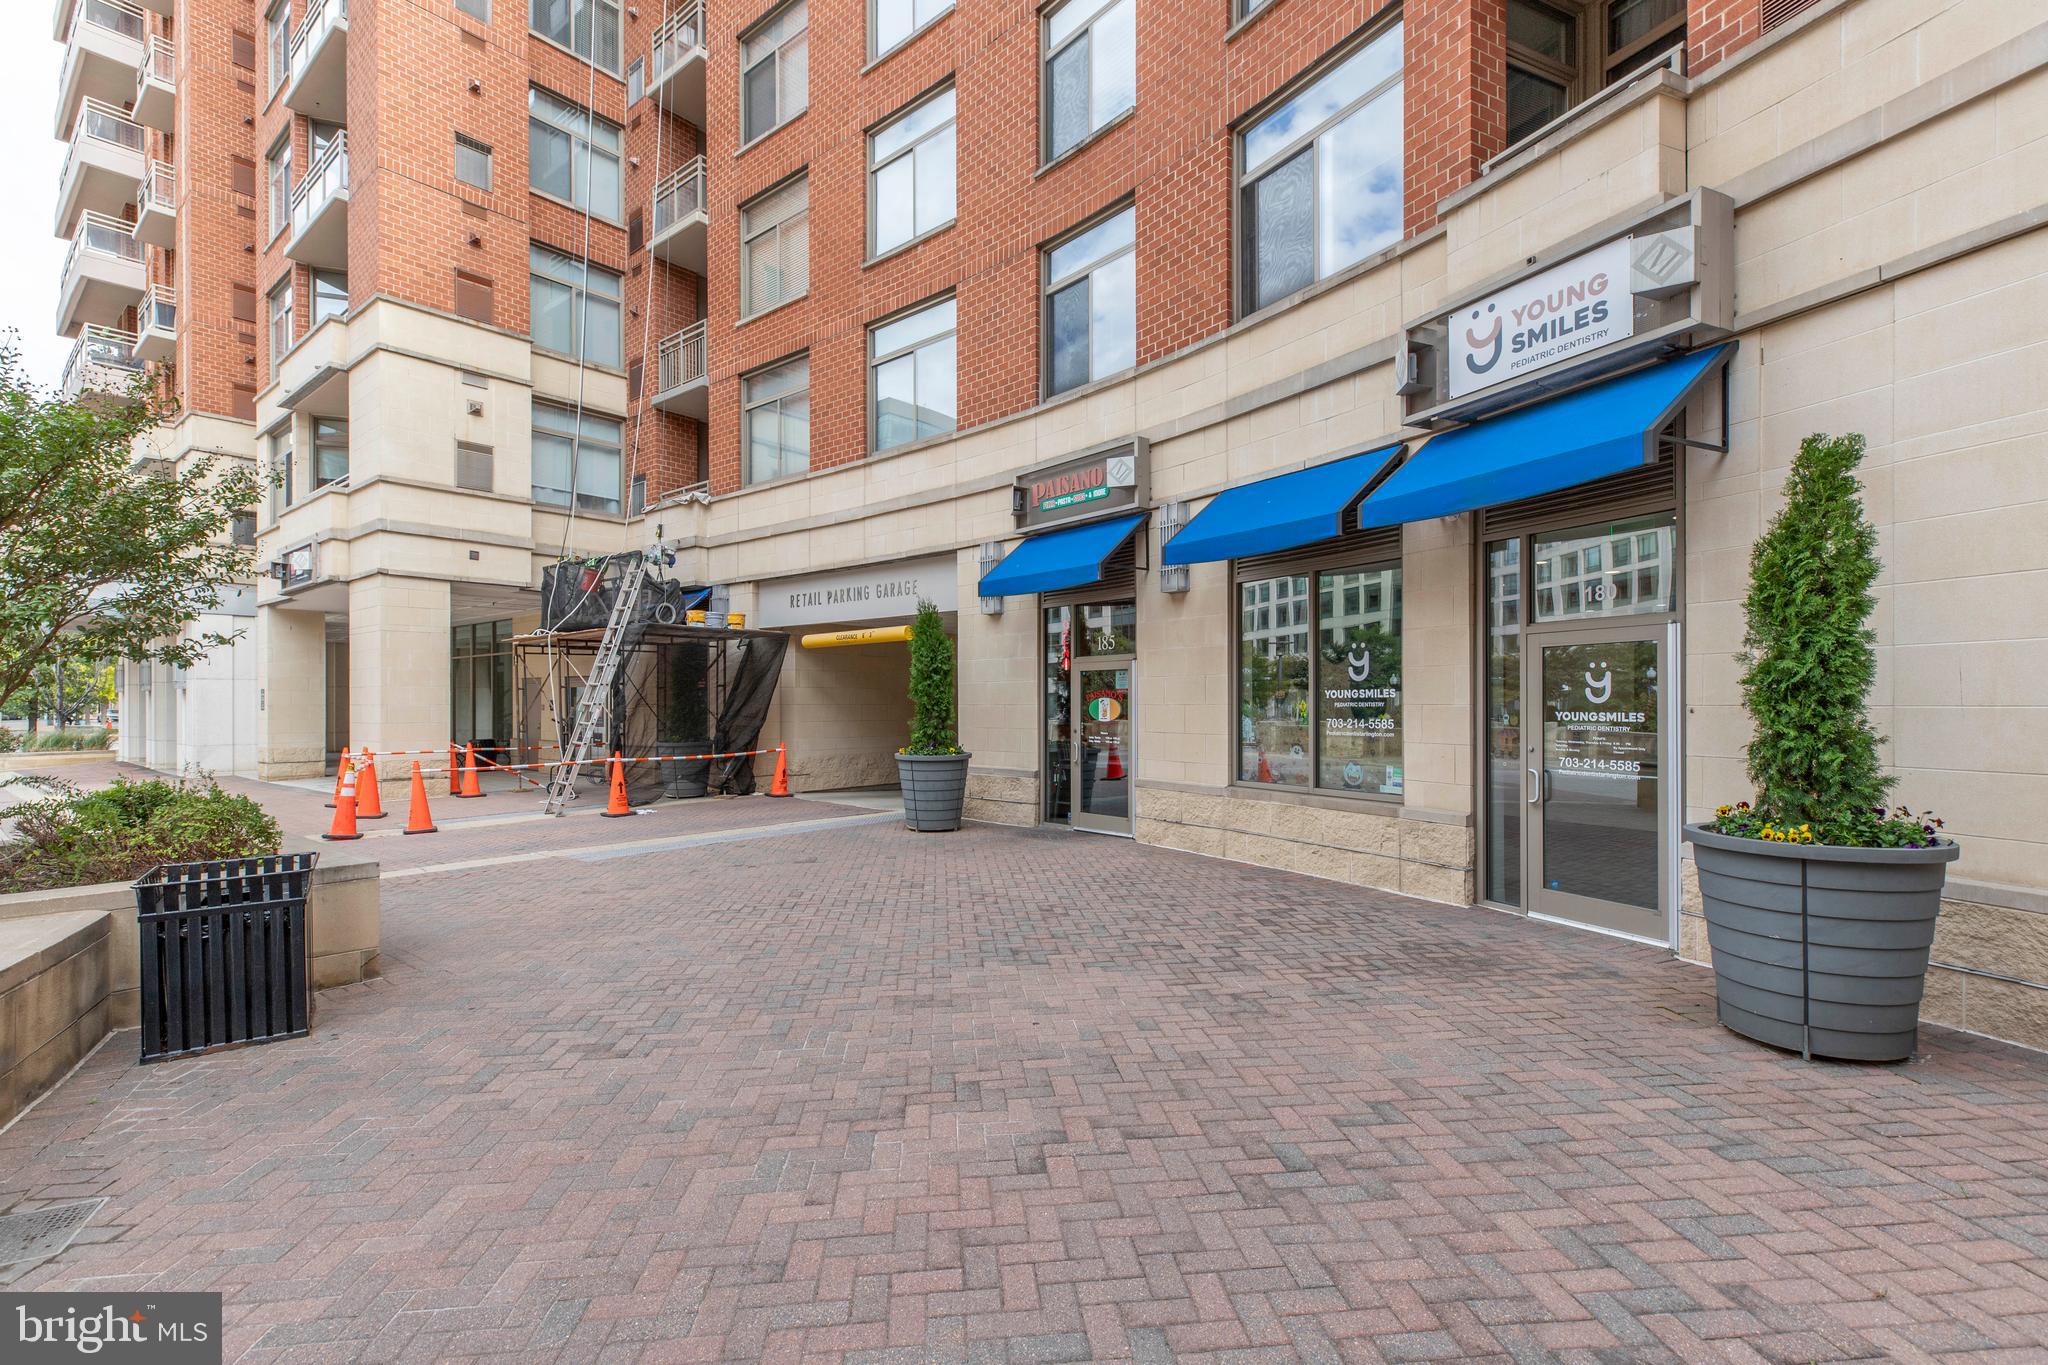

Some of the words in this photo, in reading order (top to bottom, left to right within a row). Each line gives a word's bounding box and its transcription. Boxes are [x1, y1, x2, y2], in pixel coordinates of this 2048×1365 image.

[1511, 272, 1609, 327] YOUNG
[1511, 299, 1609, 353] SMILES
[1510, 346, 1556, 370] PEDIATRIC
[1557, 327, 1609, 354] DENTISTRY
[790, 591, 822, 609] RETAIL
[827, 584, 870, 605] PARKING
[876, 579, 918, 599] GARAGE
[1585, 583, 1617, 602] 180
[1097, 635, 1115, 651] 185
[1325, 688, 1396, 699] YOUNGSMILES
[1326, 718, 1395, 729] 703-214-5585
[1555, 711, 1646, 723] YOUNGSMILES
[1597, 725, 1631, 733] DENTISTRY
[1558, 756, 1641, 772] 703-214-5585
